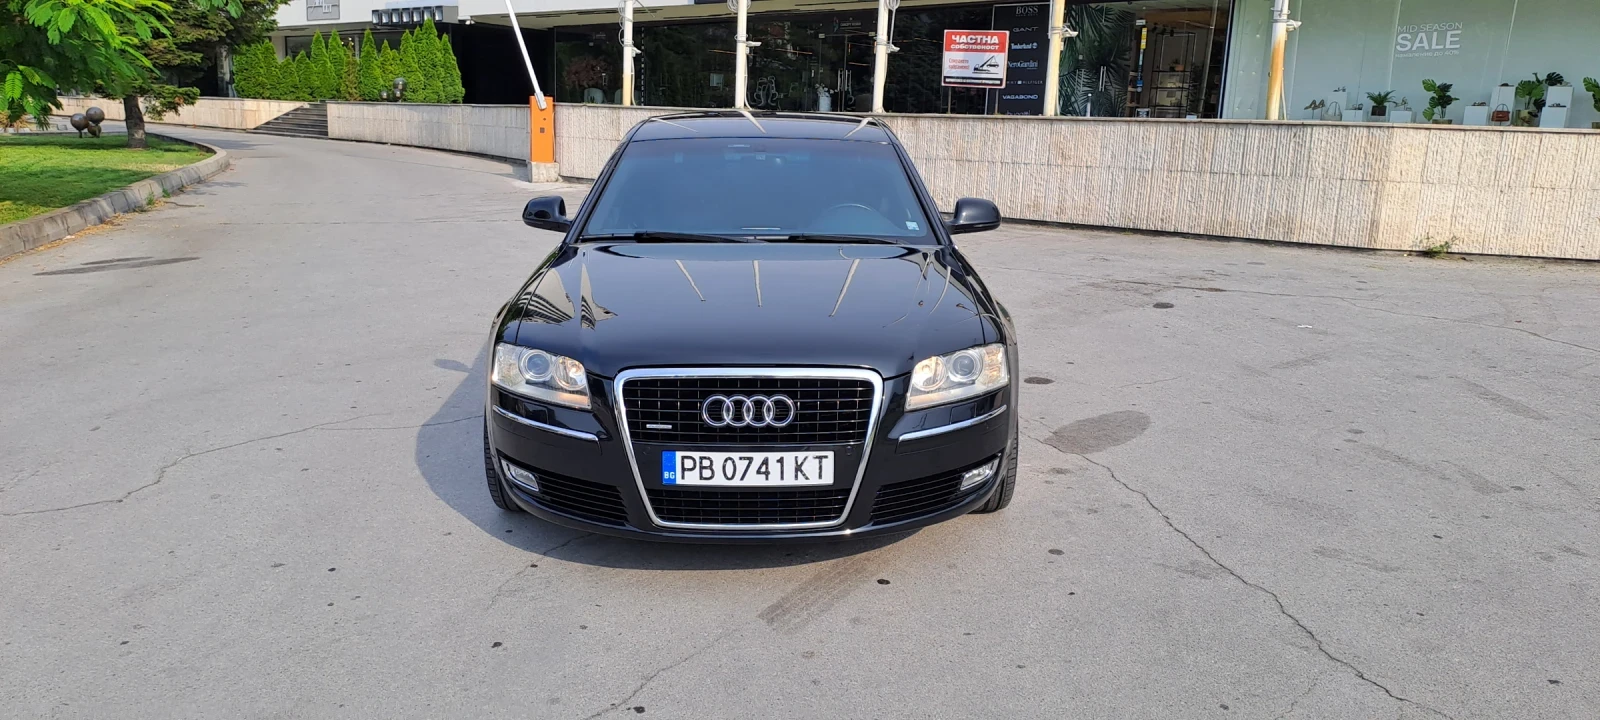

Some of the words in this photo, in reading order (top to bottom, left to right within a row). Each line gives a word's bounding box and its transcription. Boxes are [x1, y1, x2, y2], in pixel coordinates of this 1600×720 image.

[1015, 5, 1039, 14] BOSS
[1397, 24, 1418, 33] MID
[1420, 22, 1463, 32] SEASON
[952, 34, 999, 44] ЧАСТНА
[1396, 30, 1462, 52] SALE
[664, 471, 675, 479] BG
[680, 455, 715, 481] PB
[722, 456, 785, 481] 0741
[795, 455, 829, 481] KT
